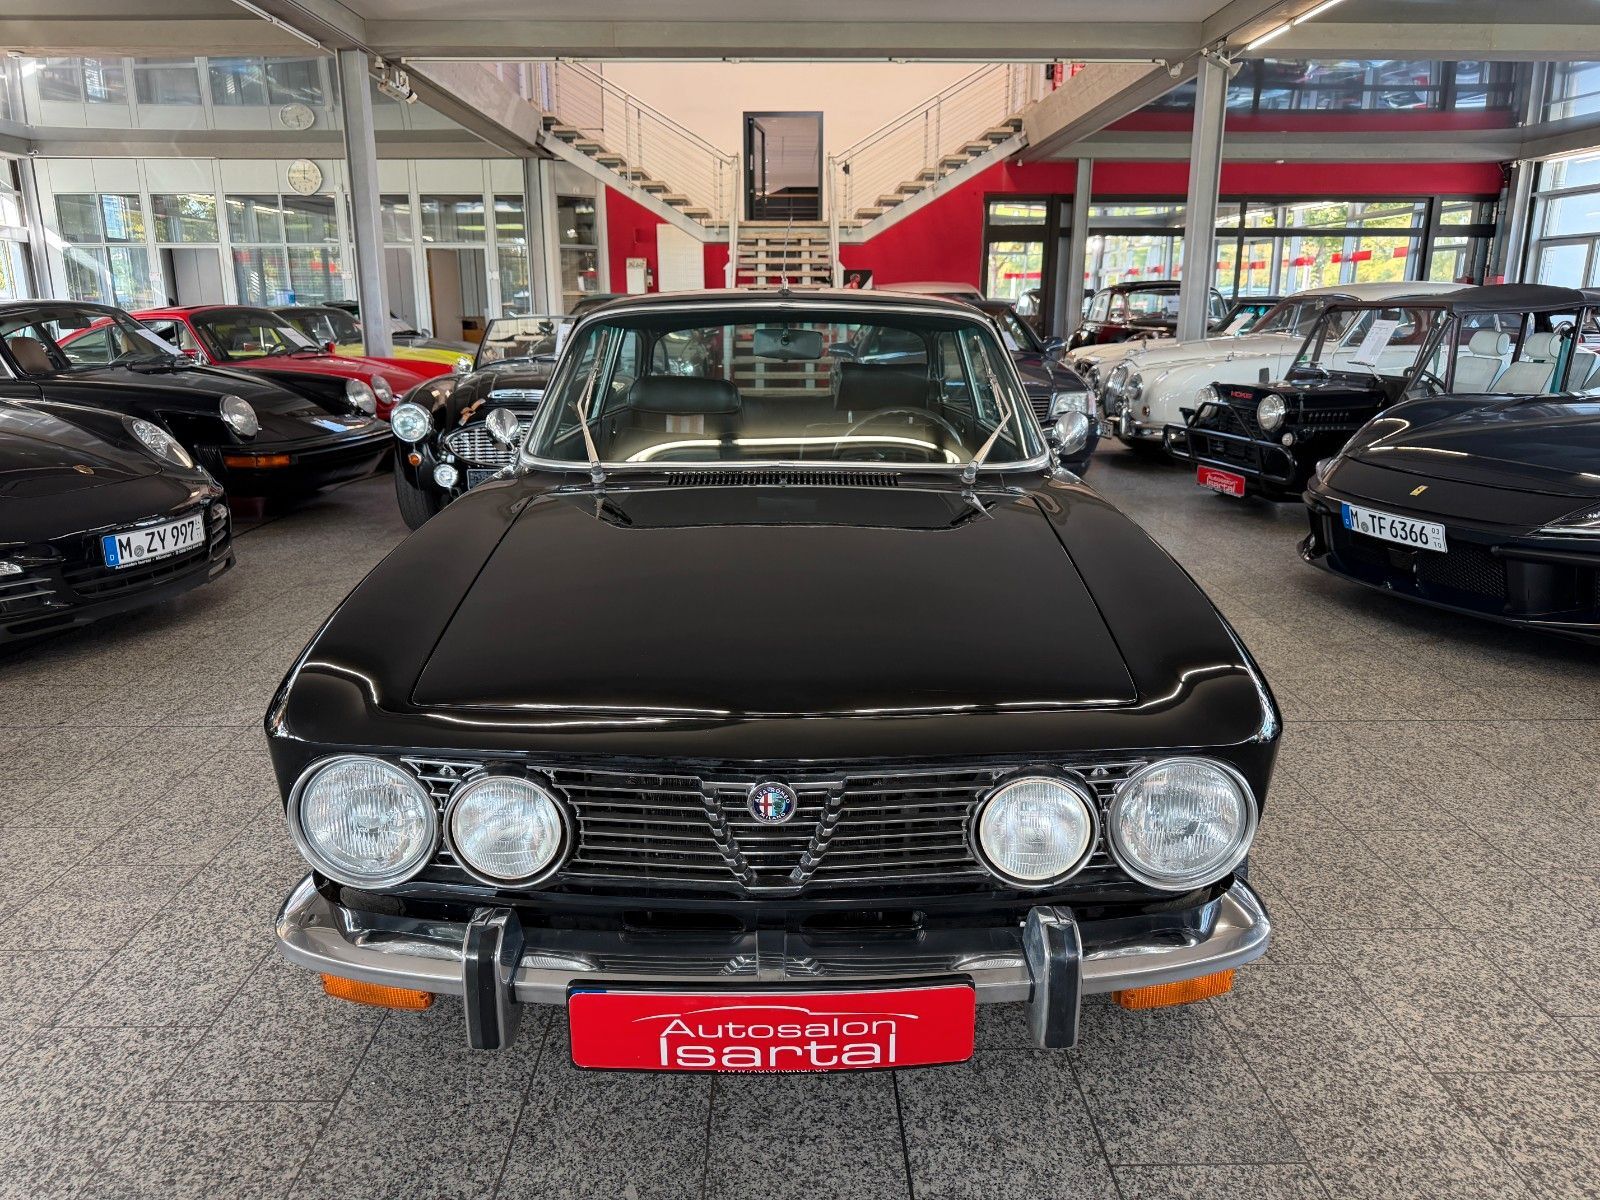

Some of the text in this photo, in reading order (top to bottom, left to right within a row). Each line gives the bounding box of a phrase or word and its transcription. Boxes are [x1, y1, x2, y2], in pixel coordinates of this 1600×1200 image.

[118, 537, 132, 559] M
[145, 528, 167, 554] ZY
[171, 521, 194, 546] 997
[1350, 509, 1429, 545] M TF 6366
[1431, 527, 1440, 535] 03
[660, 1018, 896, 1039] Autosalon
[659, 1033, 896, 1067] Isartal
